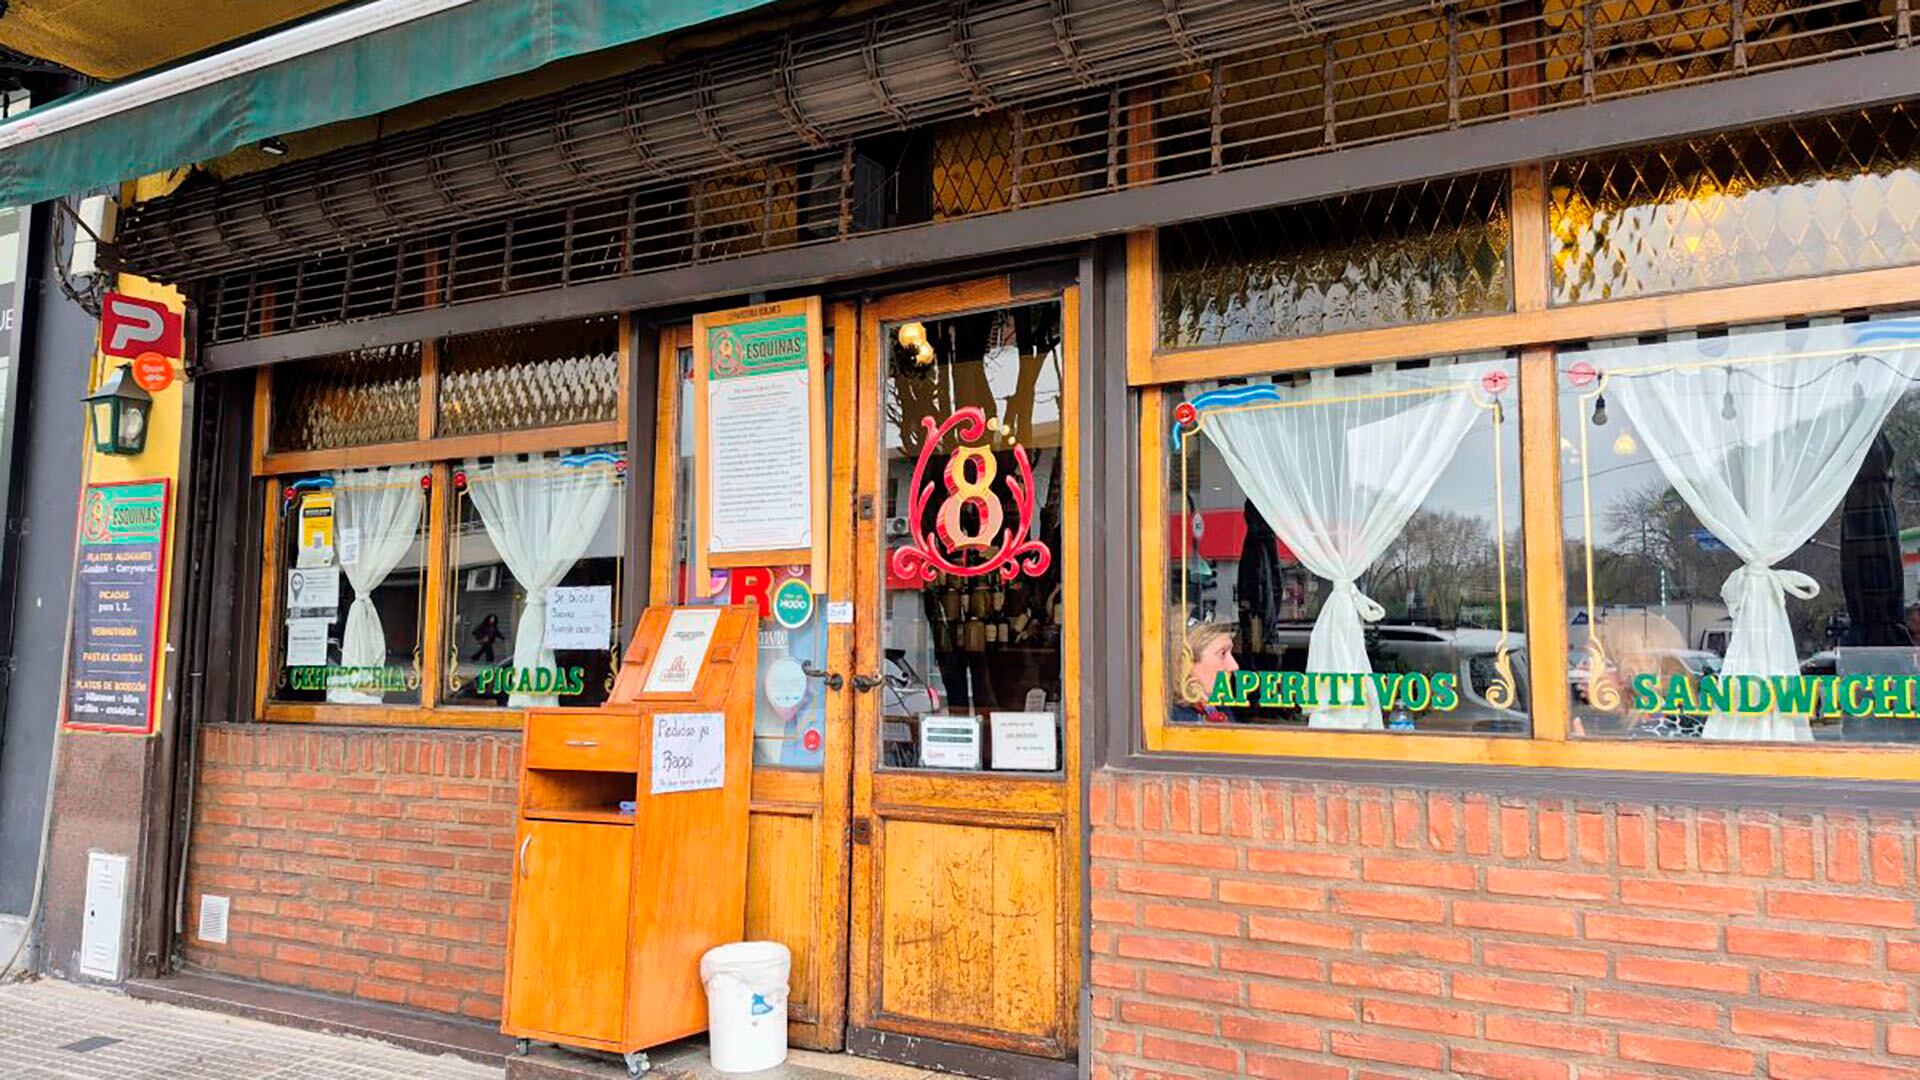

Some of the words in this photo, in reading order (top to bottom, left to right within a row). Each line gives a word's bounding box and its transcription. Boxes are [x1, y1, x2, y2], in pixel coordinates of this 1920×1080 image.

[746, 337, 801, 359] ESQUINAS
[112, 506, 159, 526] ESQUINAS
[937, 444, 1003, 554] 8
[477, 666, 585, 696] PICADAS
[1208, 671, 1460, 711] APERITIVOS
[1632, 673, 1920, 718] SANDWICH
